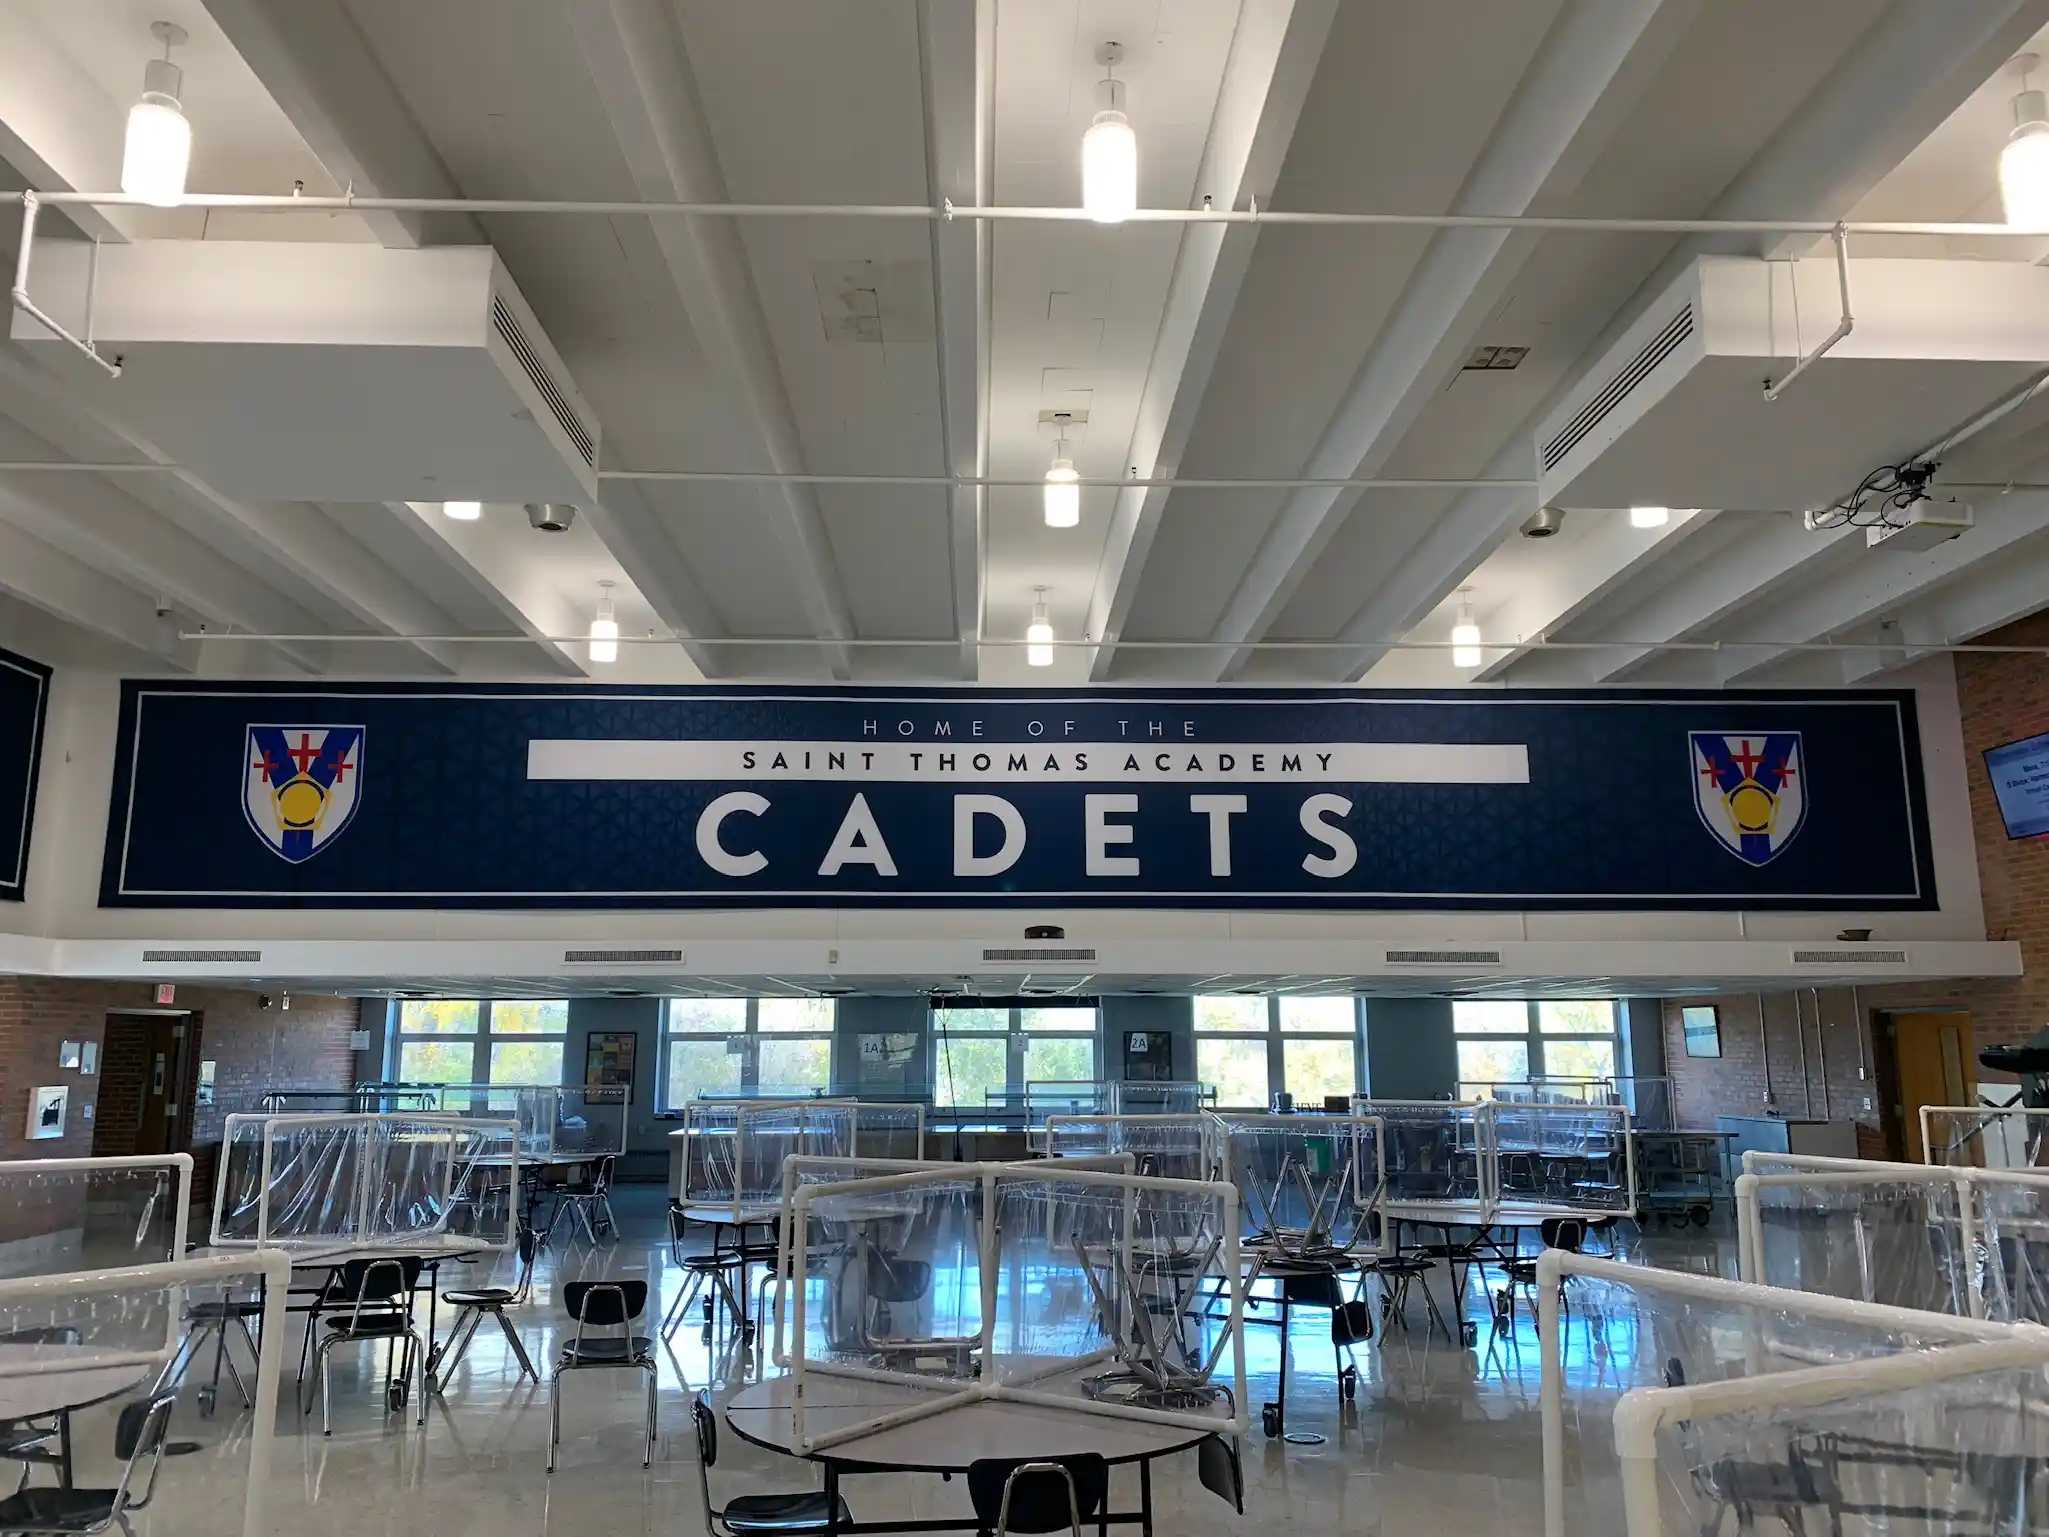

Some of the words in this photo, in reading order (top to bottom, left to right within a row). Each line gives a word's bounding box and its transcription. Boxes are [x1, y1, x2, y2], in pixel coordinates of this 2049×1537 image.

[863, 720, 983, 736] HOME
[1027, 720, 1075, 737] OF
[1118, 721, 1196, 737] THE
[743, 752, 875, 771] SAINT
[909, 753, 1088, 772] THOMAS
[1124, 754, 1333, 772] ACADEMY
[695, 791, 1358, 878] CADETS
[864, 1042, 879, 1054] 1A
[1131, 1037, 1147, 1049] 2A
